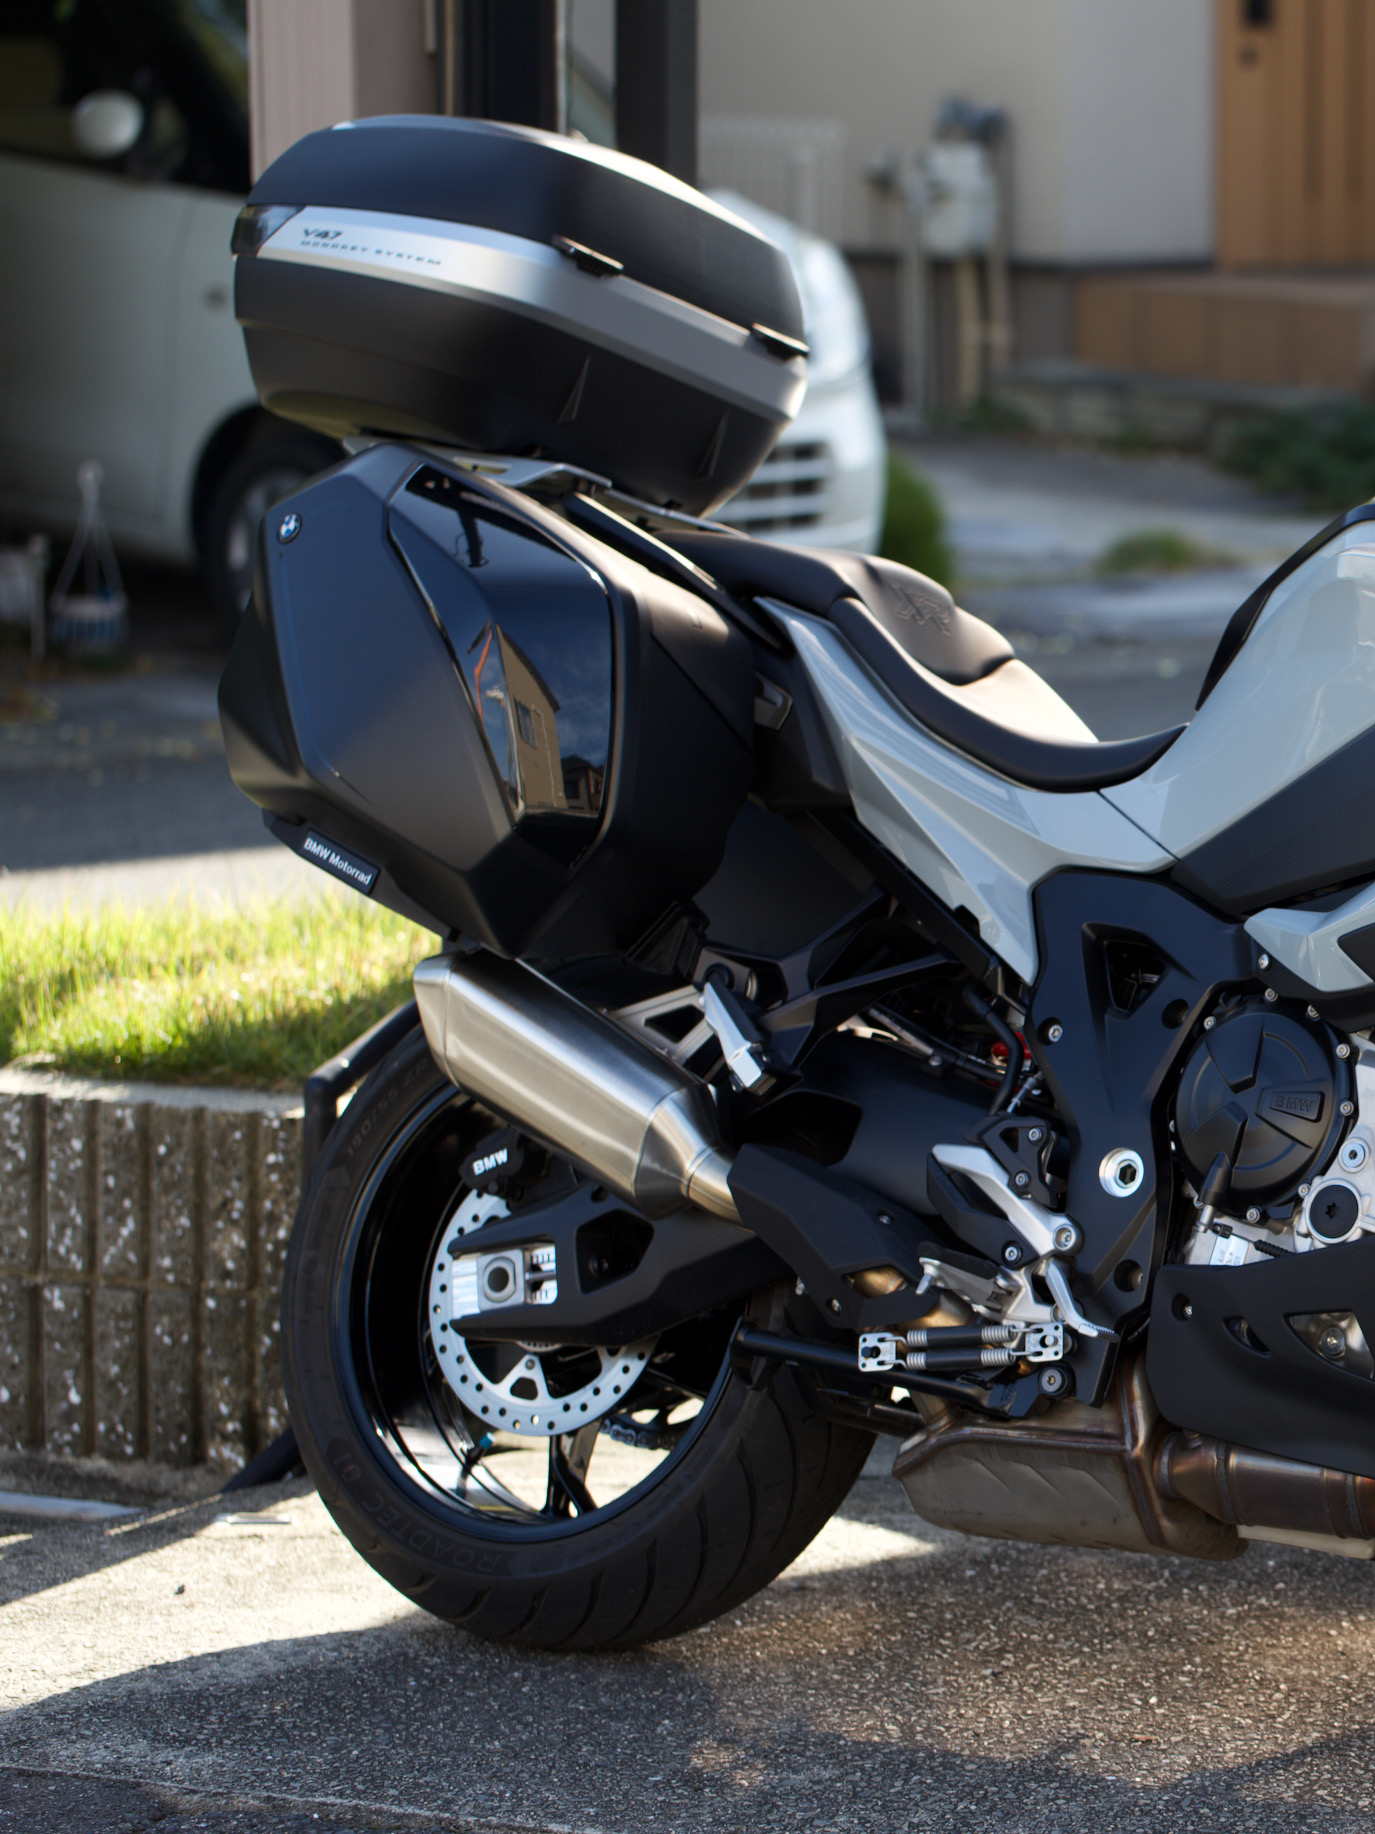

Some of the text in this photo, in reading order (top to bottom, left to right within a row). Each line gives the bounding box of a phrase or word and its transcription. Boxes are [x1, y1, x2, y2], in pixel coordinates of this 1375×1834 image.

[303, 228, 343, 241] V47
[374, 248, 441, 266] SYSTEM
[304, 837, 373, 886] BMW Motorrad
[1275, 1094, 1315, 1112] BMW
[472, 1147, 508, 1176] BMW
[362, 1491, 501, 1574] ROADTEC
